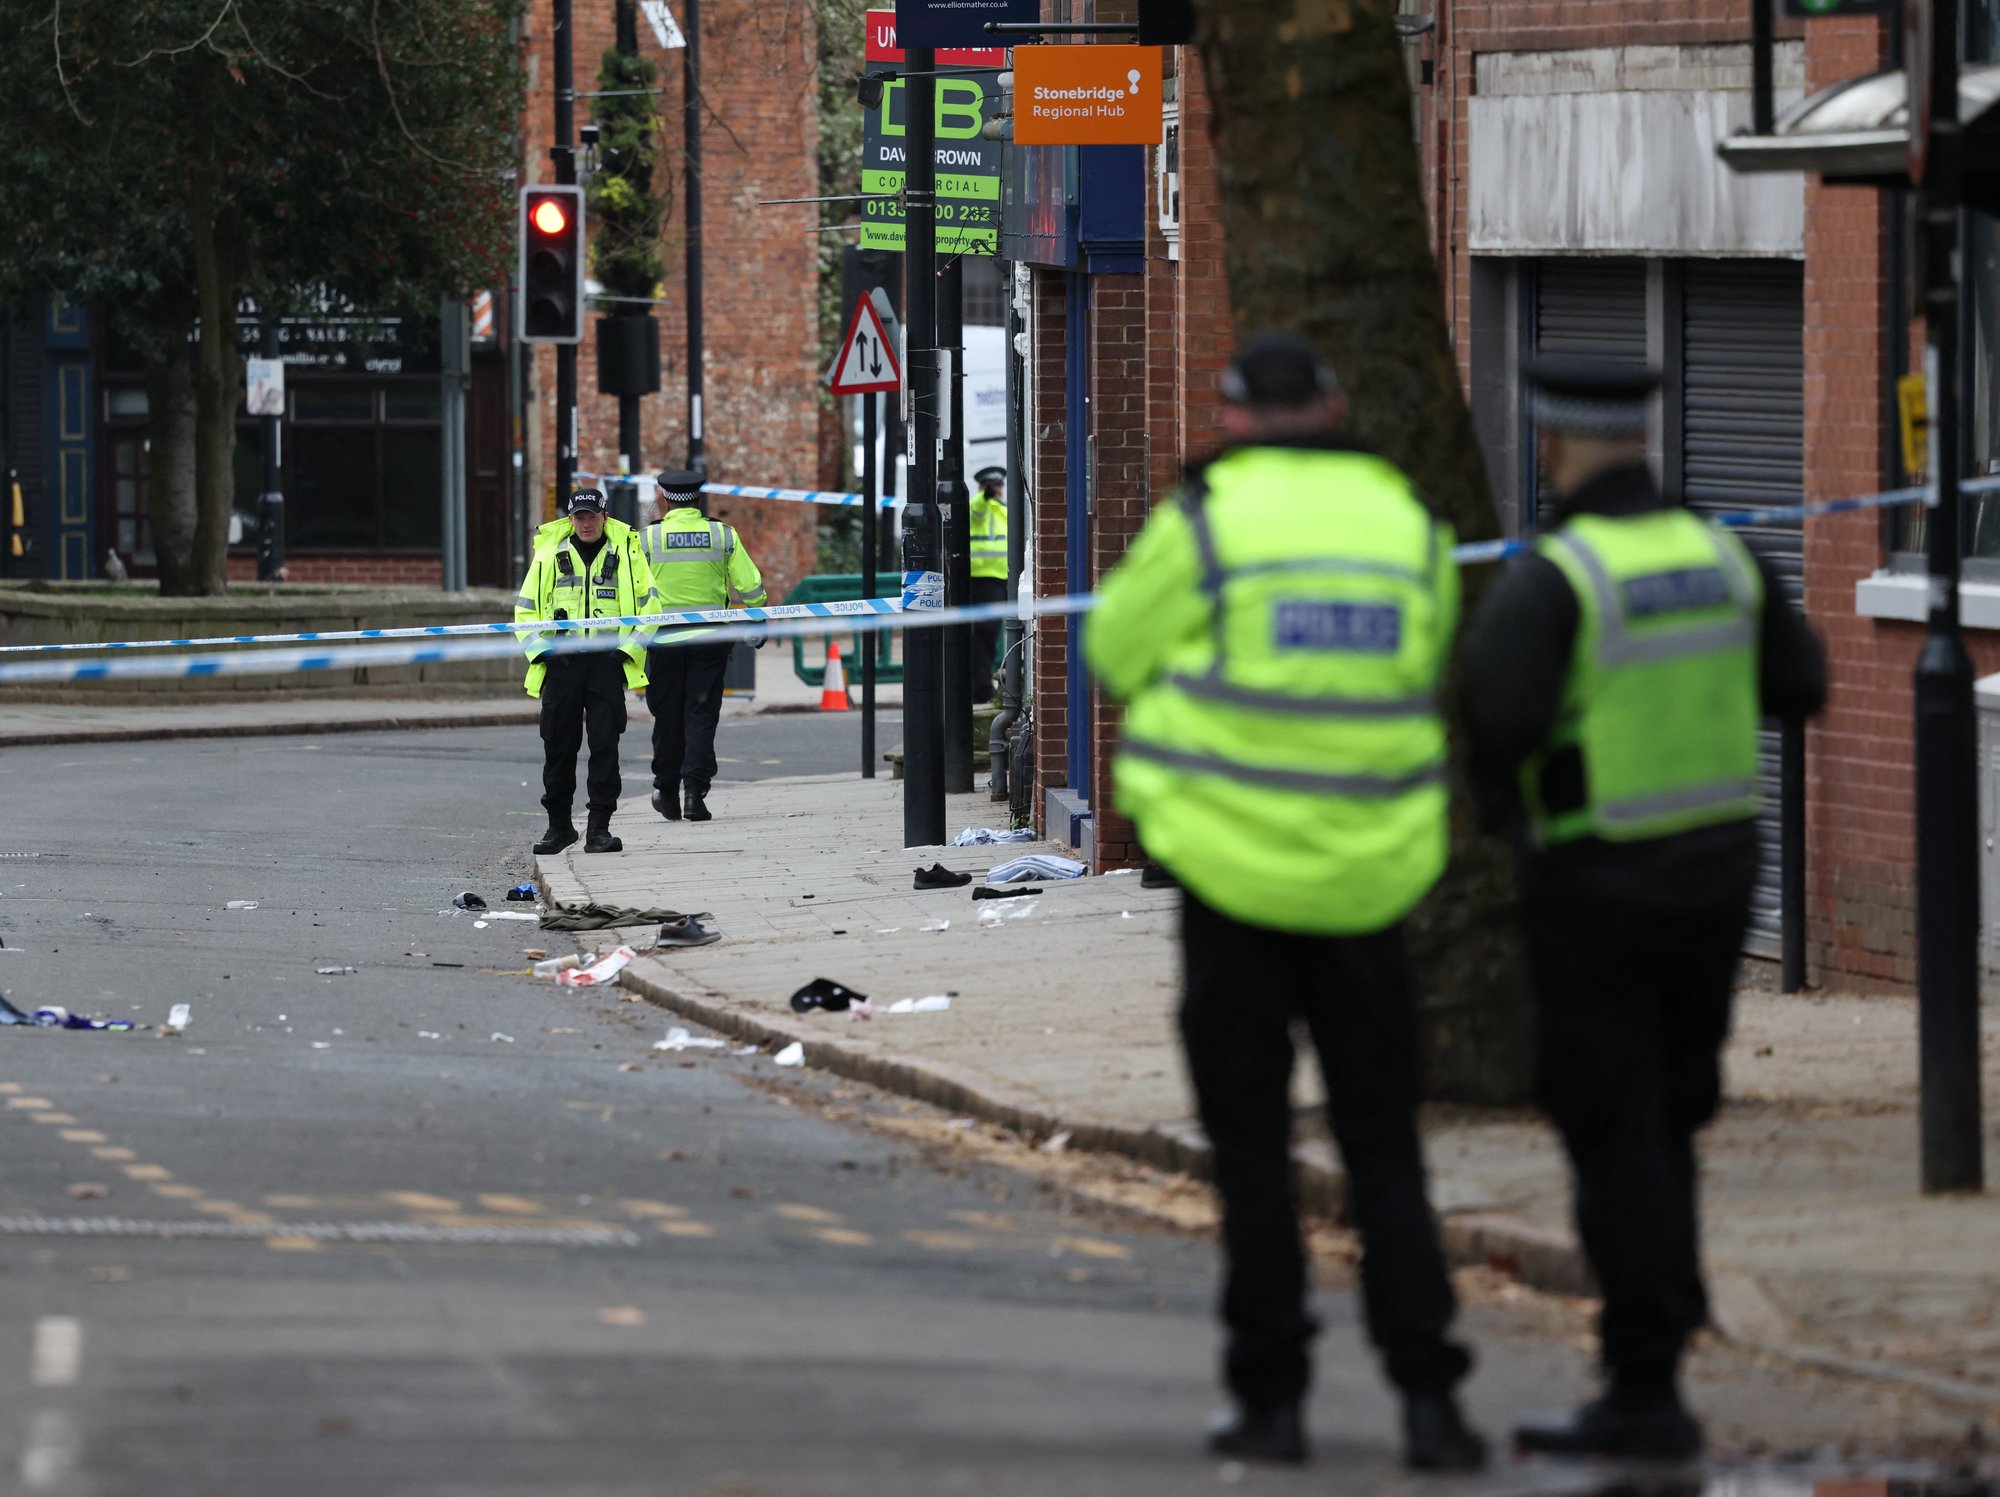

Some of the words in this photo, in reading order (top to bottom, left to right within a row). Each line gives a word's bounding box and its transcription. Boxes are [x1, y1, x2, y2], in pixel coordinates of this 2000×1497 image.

[927, 0, 1008, 9] www.elliotmather.co.uk
[1034, 87, 1125, 102] Stonebridge
[1033, 105, 1093, 120] Regional
[1097, 105, 1125, 117] Hub
[880, 146, 906, 162] DAV
[935, 149, 981, 166] ROWN
[867, 200, 906, 217] 0133
[667, 532, 710, 547] POLICE
[597, 590, 615, 598] POLICE
[919, 599, 943, 608] POLIC
